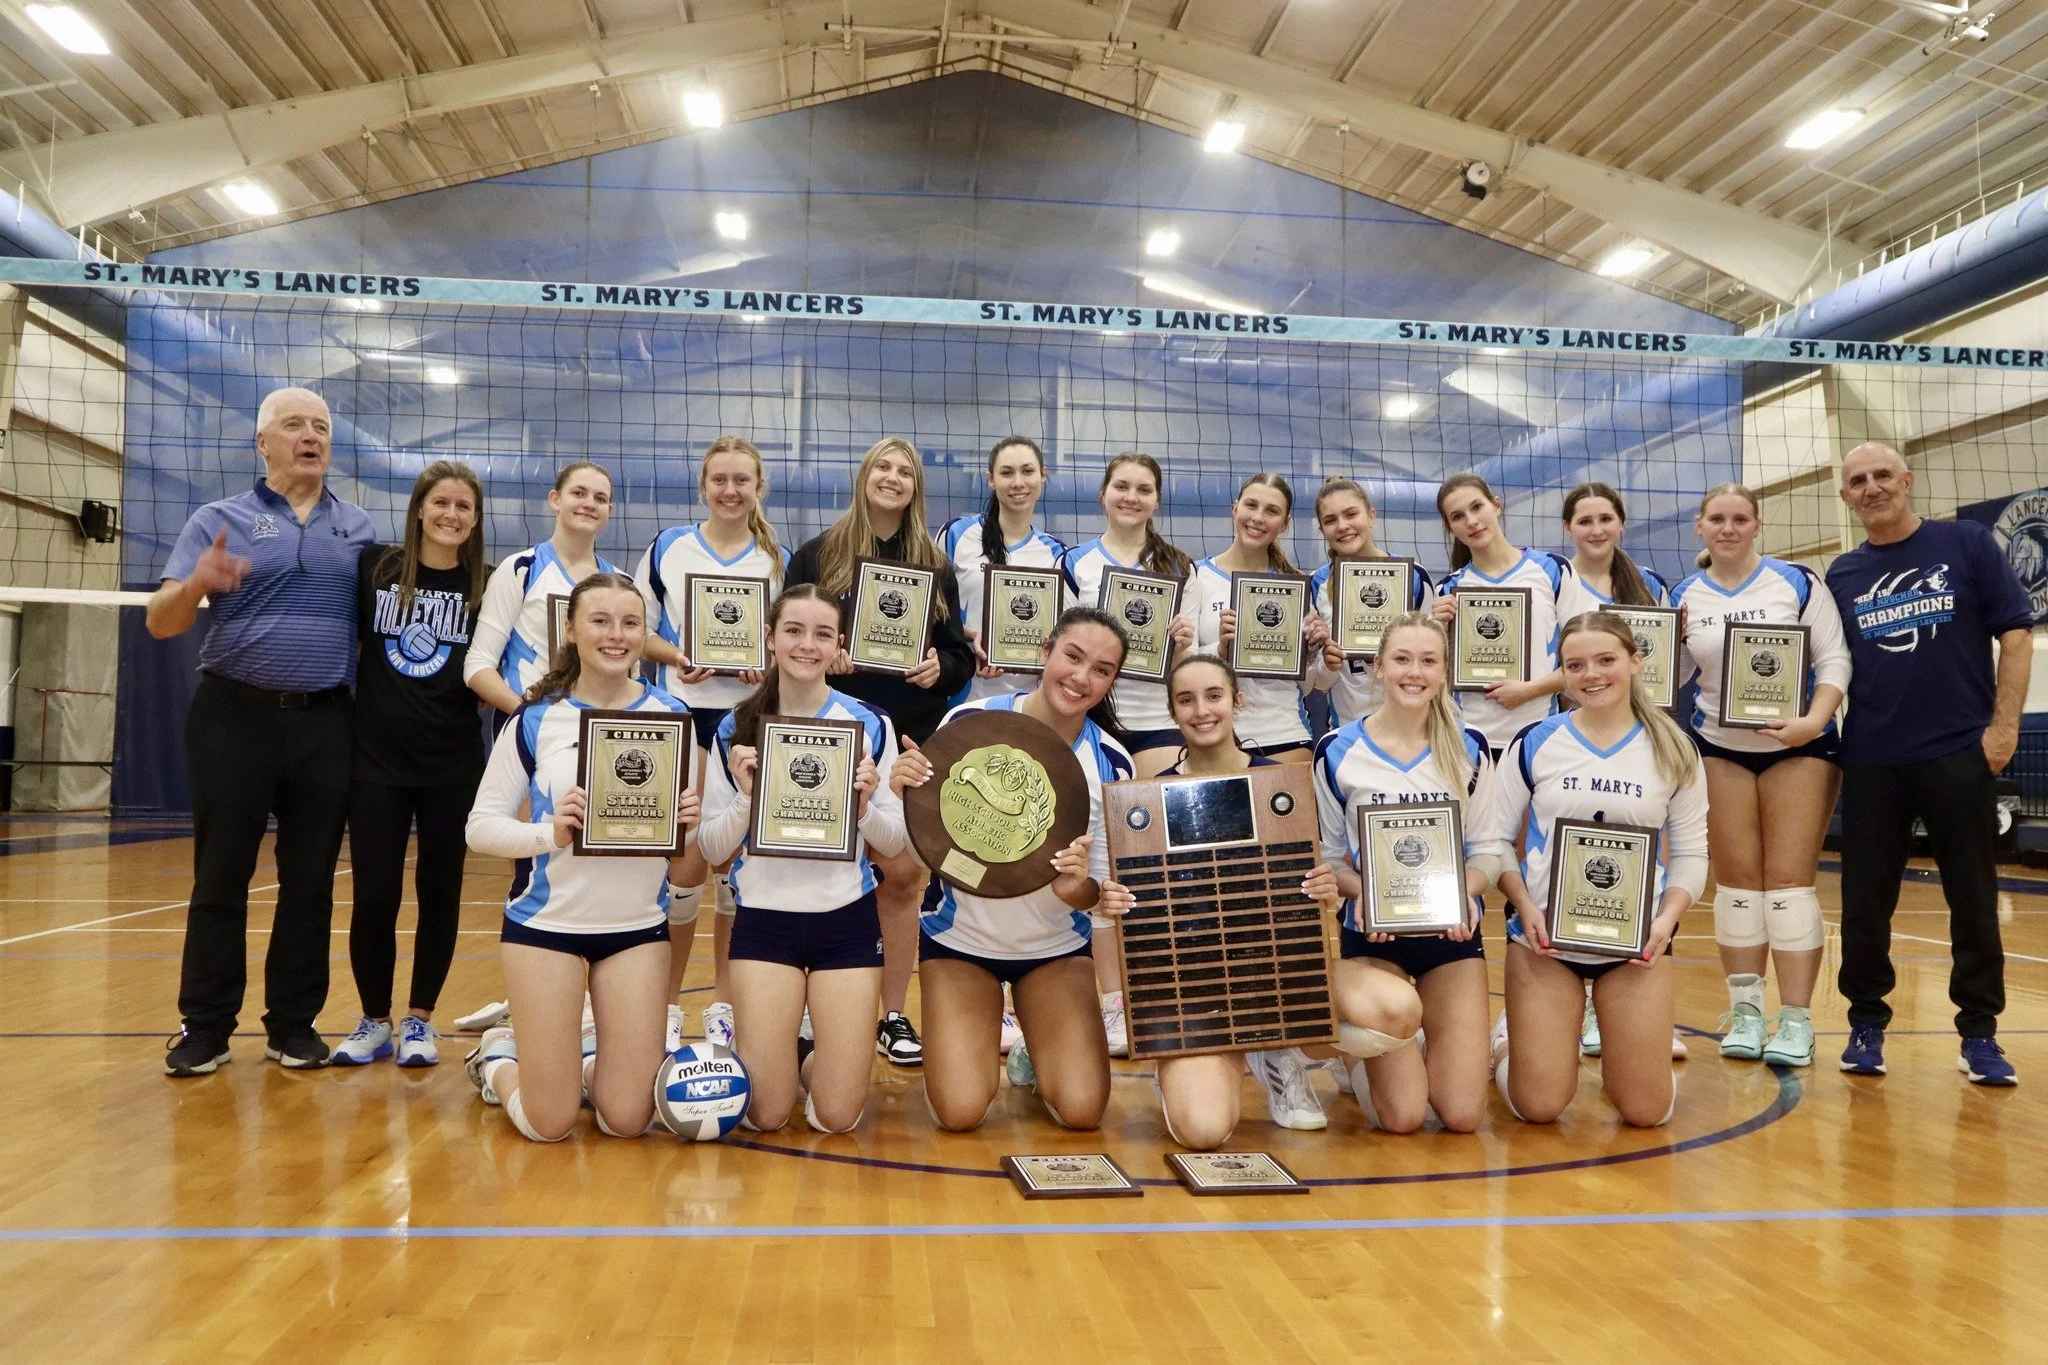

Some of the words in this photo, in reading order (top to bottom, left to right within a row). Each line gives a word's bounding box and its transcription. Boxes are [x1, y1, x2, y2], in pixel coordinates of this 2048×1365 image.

[85, 262, 128, 283] ST.
[143, 265, 260, 290] MARY'S
[275, 271, 420, 297] LANCERS
[541, 284, 584, 304] ST.
[596, 286, 709, 308] MARY'S
[723, 291, 863, 315] LANCERS
[980, 302, 1021, 321] ST.
[1033, 304, 1142, 327] MARY'S
[1155, 310, 1289, 334] LANCERS
[1399, 322, 1437, 340] ST.
[1448, 324, 1550, 347] MARY'S
[1562, 329, 1687, 352] LANCERS
[1789, 340, 1826, 358] ST.
[1835, 342, 1932, 363] MARY'S
[1943, 346, 2048, 368] LANCER
[2007, 496, 2048, 527] LANCE
[880, 574, 913, 585] CHSAA
[1009, 580, 1041, 588] CHSAA
[414, 588, 463, 601] MARY'S
[1126, 583, 1158, 594] CHSAA
[1255, 587, 1287, 595] CHSAA
[374, 589, 469, 643] VOLLEYBALL
[1723, 609, 1766, 623] MARY'S
[1858, 595, 1954, 629] CHAMPIONS
[870, 624, 910, 637] STATE
[1005, 626, 1042, 637] STATE
[863, 634, 914, 647] CHAMPIONS
[999, 636, 1044, 646] CHAMPION
[1250, 633, 1286, 644] STATE
[1750, 637, 1784, 645] CHSAA
[1244, 643, 1292, 652] CHAMPIONS
[388, 649, 406, 670] LADY
[408, 654, 445, 676] LANCERS
[614, 731, 658, 740] CHSAA
[789, 735, 832, 745] CHSAA
[1563, 777, 1582, 790] ST.
[1591, 778, 1642, 798] MARY'S
[606, 794, 658, 807] STATE
[781, 796, 830, 810] STATE
[598, 808, 665, 818] CHAMPIONS
[772, 809, 837, 821] CHAMPIONS
[947, 789, 971, 811] HIGH
[973, 805, 1018, 833] SCHOOLS
[965, 814, 1007, 841] ATHLETIC
[1388, 819, 1430, 828] CHSAA
[952, 820, 1012, 856] ASSOCIATION
[1584, 838, 1626, 849] CHSAA
[1576, 895, 1623, 911] STATE
[1568, 906, 1631, 921] CHAMPIONS
[678, 1061, 733, 1079] molten
[686, 1079, 731, 1098] NCAA
